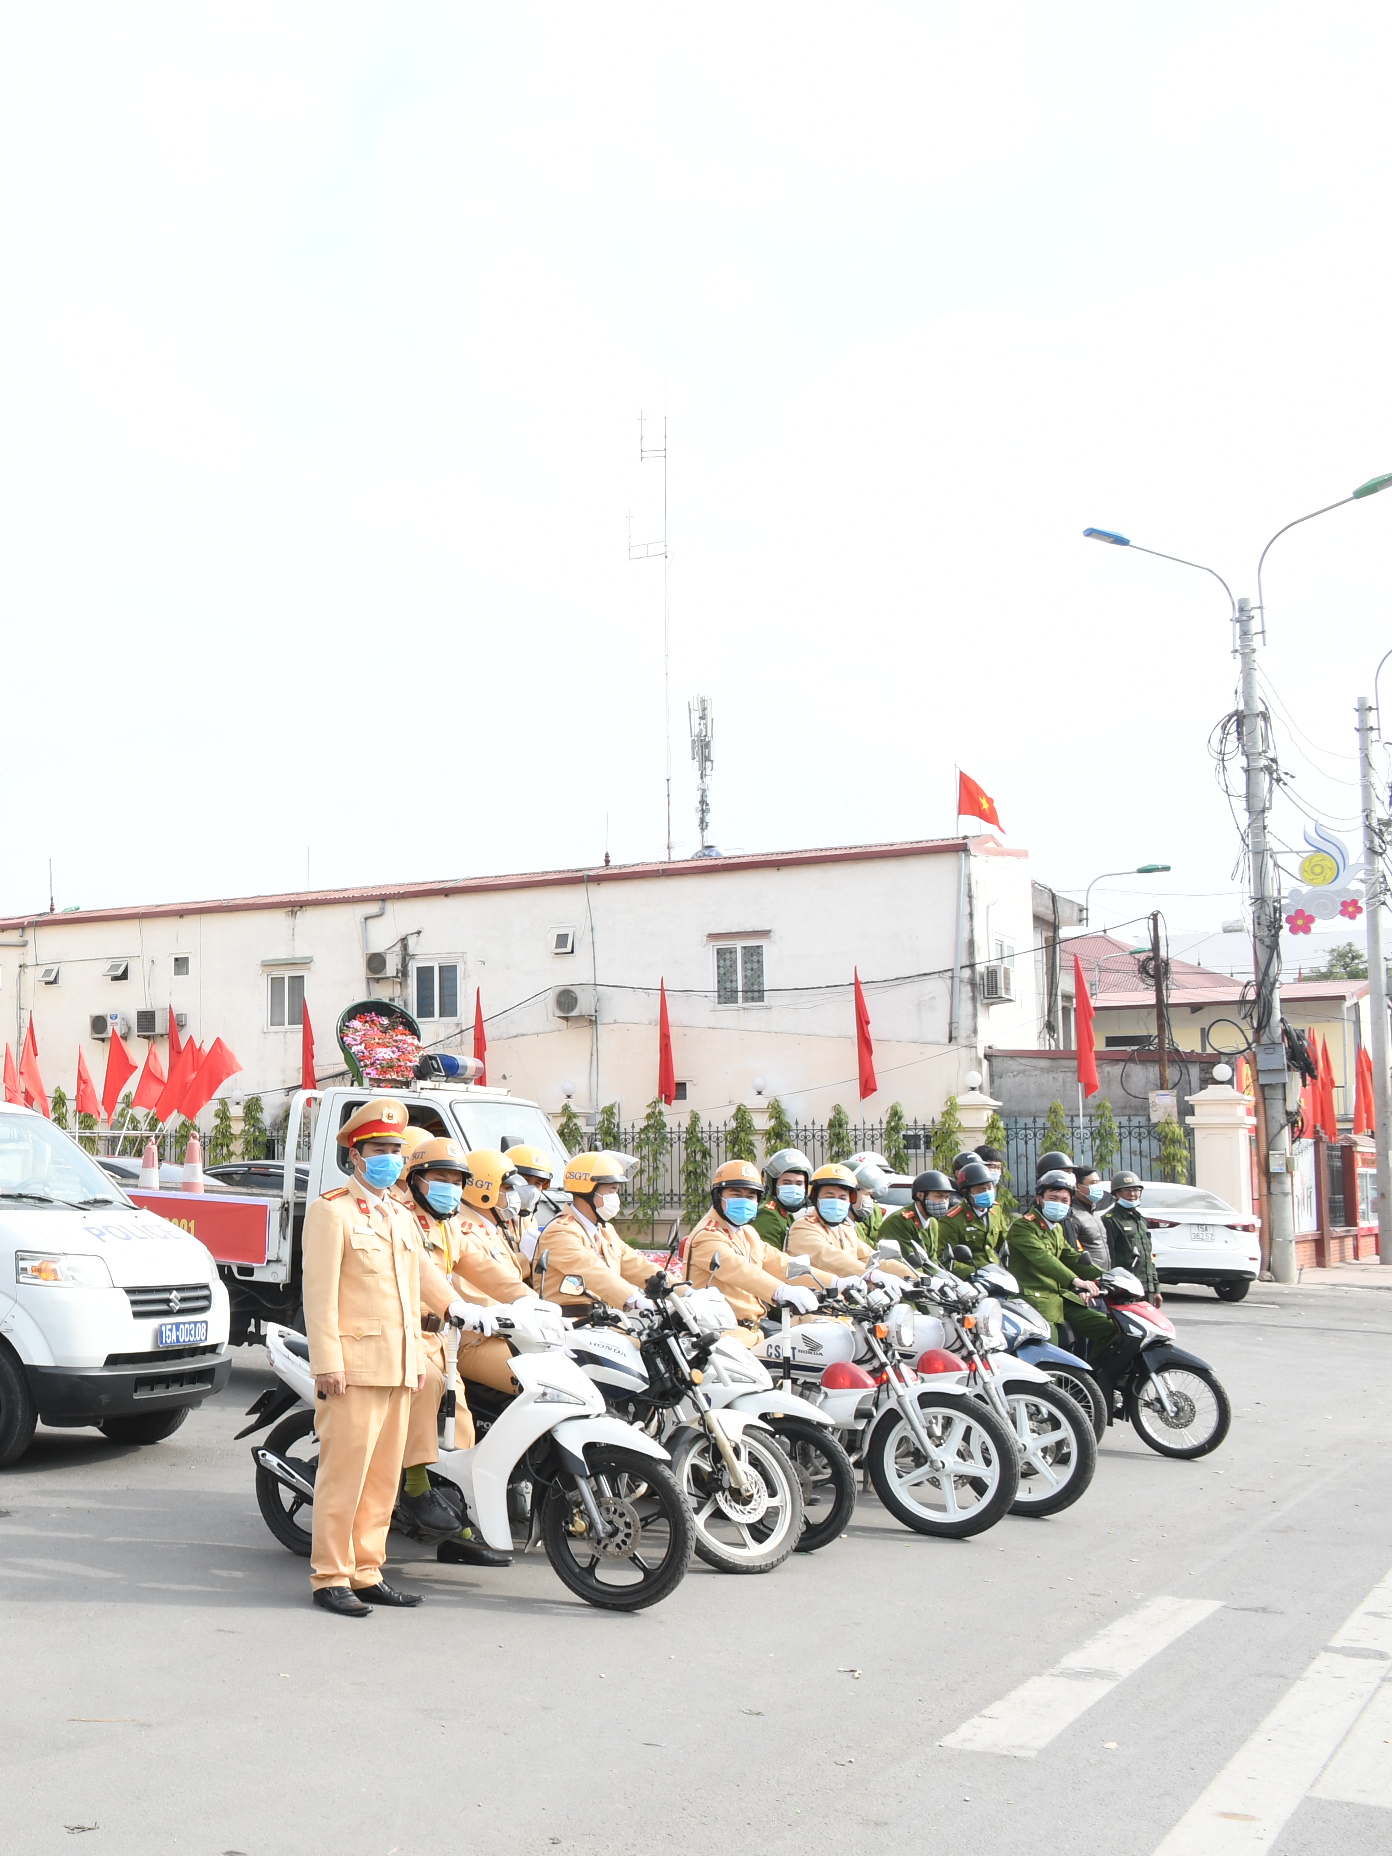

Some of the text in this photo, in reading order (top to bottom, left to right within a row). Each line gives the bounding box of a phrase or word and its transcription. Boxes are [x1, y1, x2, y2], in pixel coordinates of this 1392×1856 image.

[466, 1177, 493, 1191] SGT
[589, 1341, 627, 1359] HONDA
[766, 1344, 797, 1360] CST
